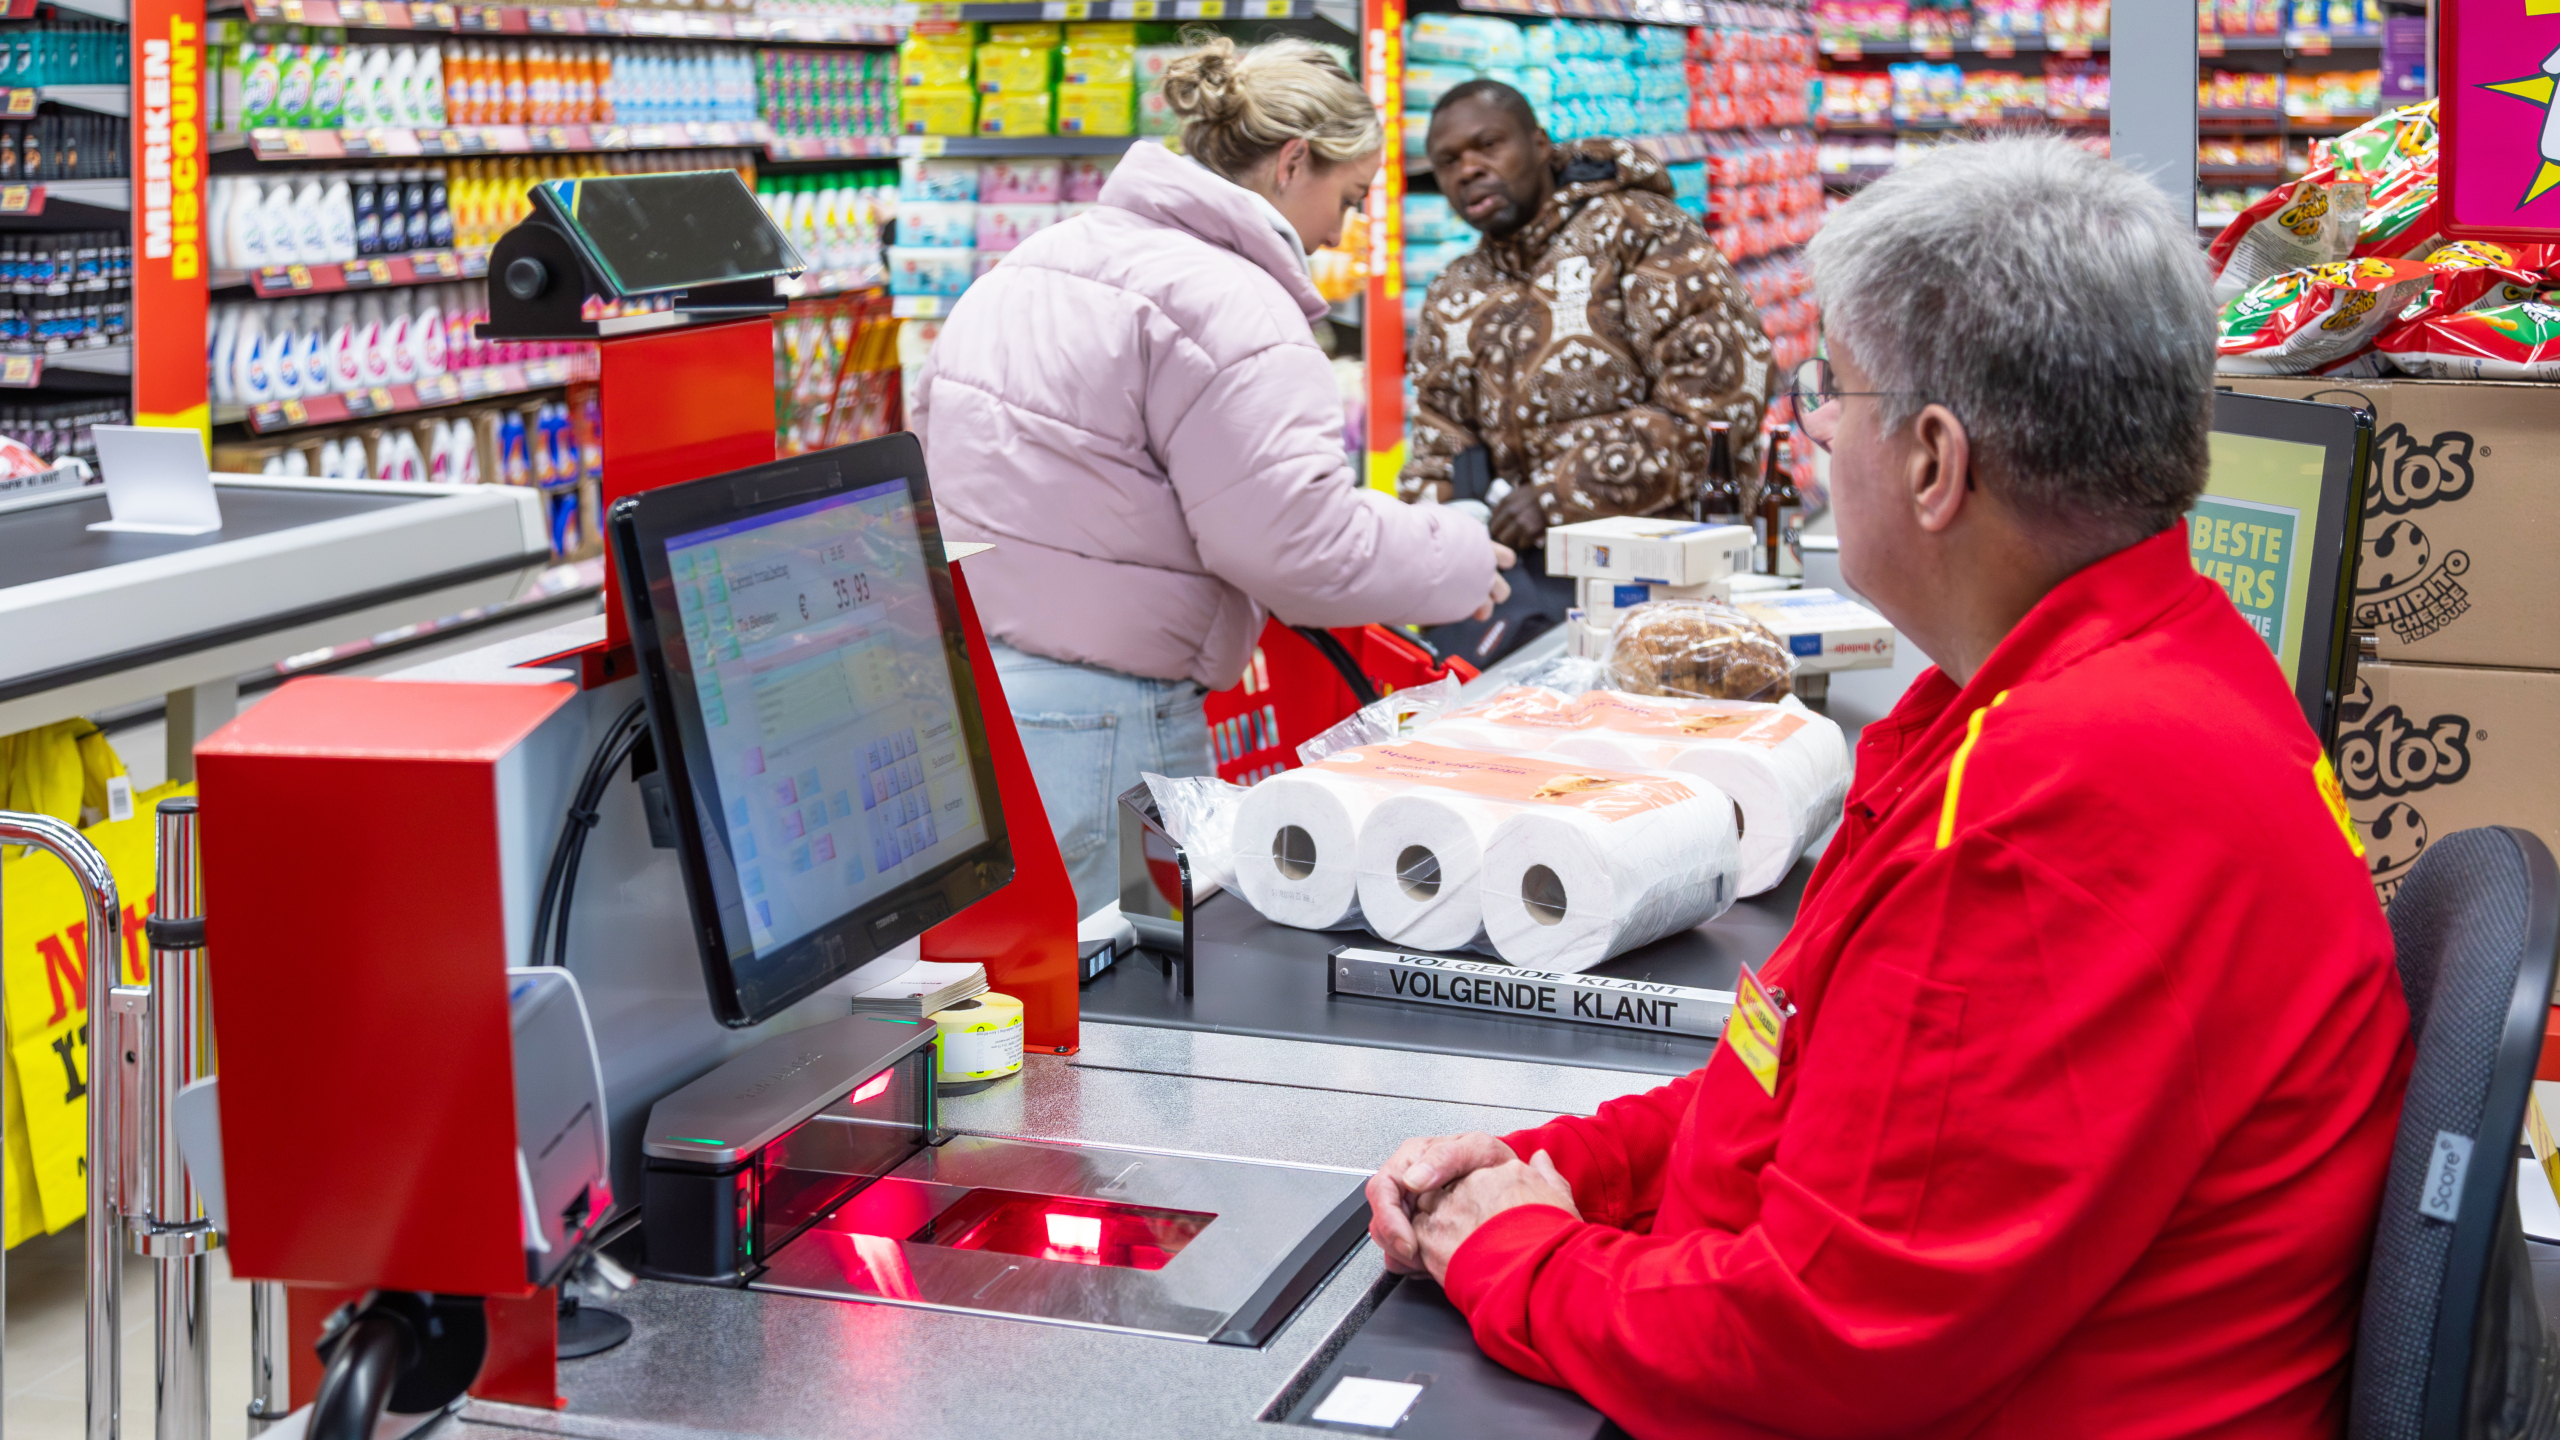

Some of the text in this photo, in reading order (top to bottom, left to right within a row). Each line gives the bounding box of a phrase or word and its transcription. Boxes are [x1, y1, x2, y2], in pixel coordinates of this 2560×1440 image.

[144, 39, 172, 259] MERKEN
[170, 14, 199, 280] DISCOUNT
[2192, 515, 2282, 563] BESTE
[833, 572, 870, 609] 35,93
[2391, 585, 2468, 634] CHEESE
[2401, 601, 2471, 645] FLAVOUR
[1389, 969, 1679, 1028] VOLGENDE KLANT
[1397, 955, 1687, 996] VOLGENDE KLANT
